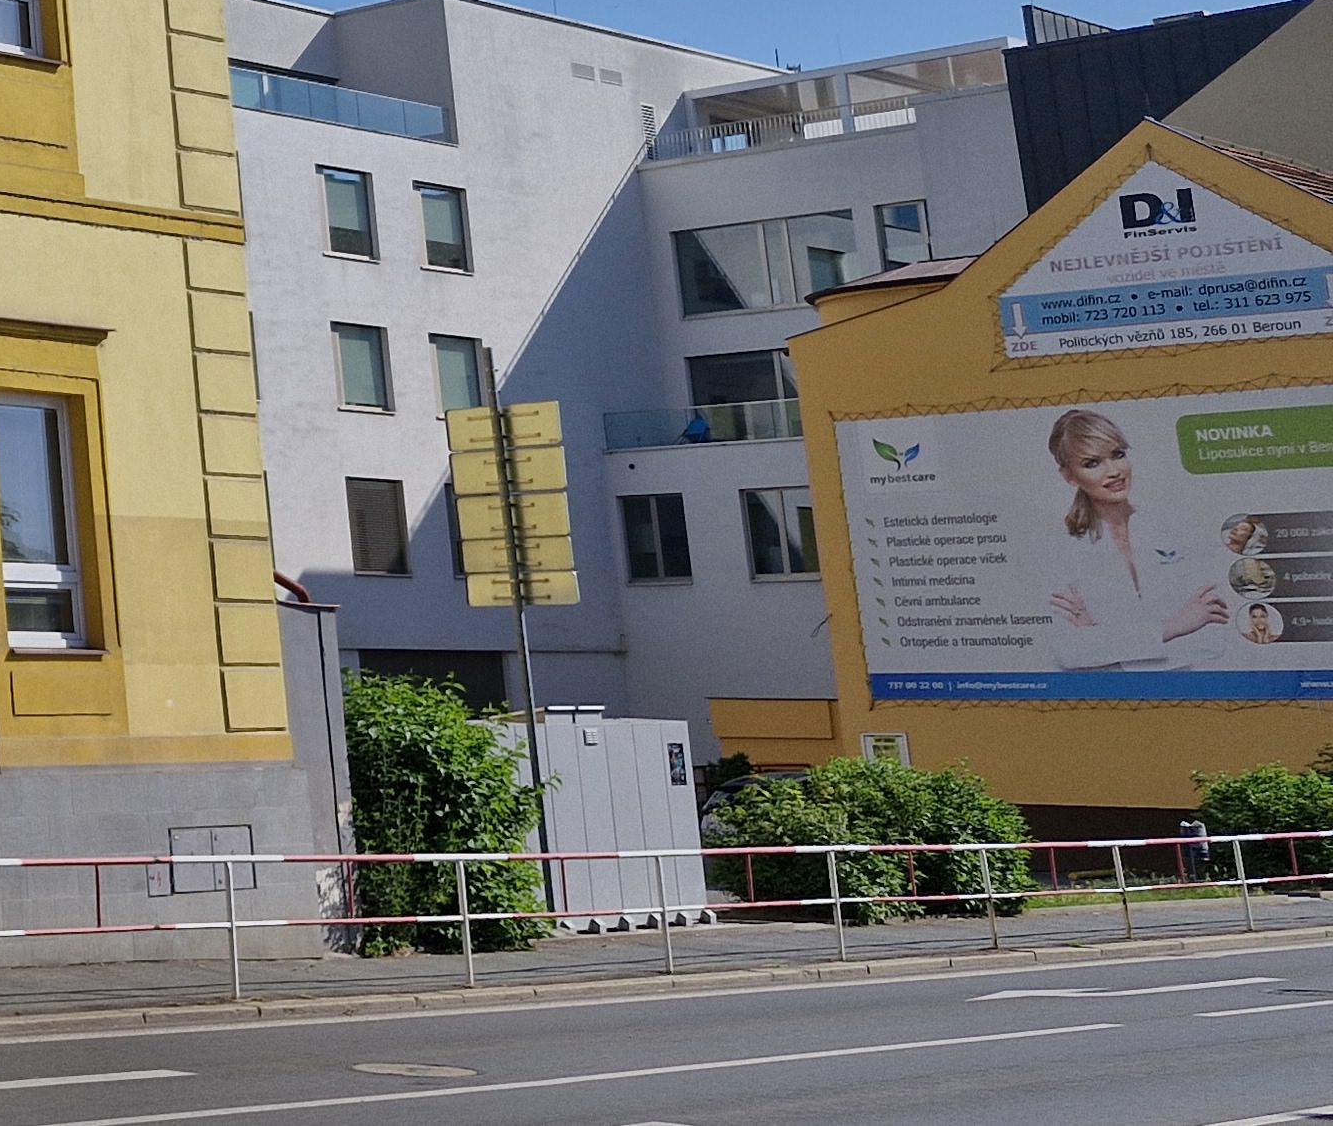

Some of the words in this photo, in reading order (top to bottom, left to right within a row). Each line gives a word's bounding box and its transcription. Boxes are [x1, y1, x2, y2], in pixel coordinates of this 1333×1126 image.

[1118, 188, 1196, 229] D&I
[1124, 225, 1197, 239] FinServis
[1049, 241, 1170, 273] NEJLEVNĚJŠÍ
[1178, 233, 1284, 259] POJIŠTĚNÍ
[1107, 265, 1158, 284] vozidel
[1161, 267, 1177, 279] ve
[1180, 261, 1226, 278] městě
[1041, 292, 1121, 309] www.difin.cz
[1147, 284, 1192, 300] e-mail:
[1198, 276, 1307, 296] dprusa@difin.cz
[1042, 309, 1080, 325] mobil:
[1085, 308, 1108, 322] 723
[1113, 306, 1137, 319] 720
[1141, 304, 1165, 317] 113
[1193, 298, 1219, 312] tel.:
[1224, 296, 1249, 310] 311
[1254, 293, 1280, 307] 623
[1285, 291, 1311, 304] 975
[1058, 332, 1124, 350] Politických
[1127, 327, 1165, 342] vězňů
[1170, 326, 1197, 341] 185,
[1203, 324, 1227, 337] 266
[1231, 322, 1248, 334] 01
[1253, 319, 1301, 333] Beroun
[1011, 340, 1038, 352] ZDE
[1195, 424, 1274, 441] NOVINKA
[1198, 445, 1264, 461] Liposukce
[1296, 444, 1305, 453] v
[883, 515, 929, 528] Estetická
[931, 513, 998, 526] dermatologie
[886, 536, 931, 548] Plastické
[933, 536, 974, 547] operace
[977, 534, 1007, 546] prsou
[889, 556, 933, 568] Plastické
[936, 555, 977, 567] operace
[979, 552, 1008, 564] víček
[892, 575, 927, 587] Intimní
[929, 575, 975, 586] medicína
[894, 595, 922, 607] Cévní
[925, 594, 981, 606] ambulance
[897, 615, 952, 627] Odstranění
[955, 614, 1008, 626] znamének
[1010, 613, 1052, 625] laserem
[900, 636, 949, 648] Ortopedie
[952, 638, 959, 646] a
[961, 635, 1034, 648] traumatologie
